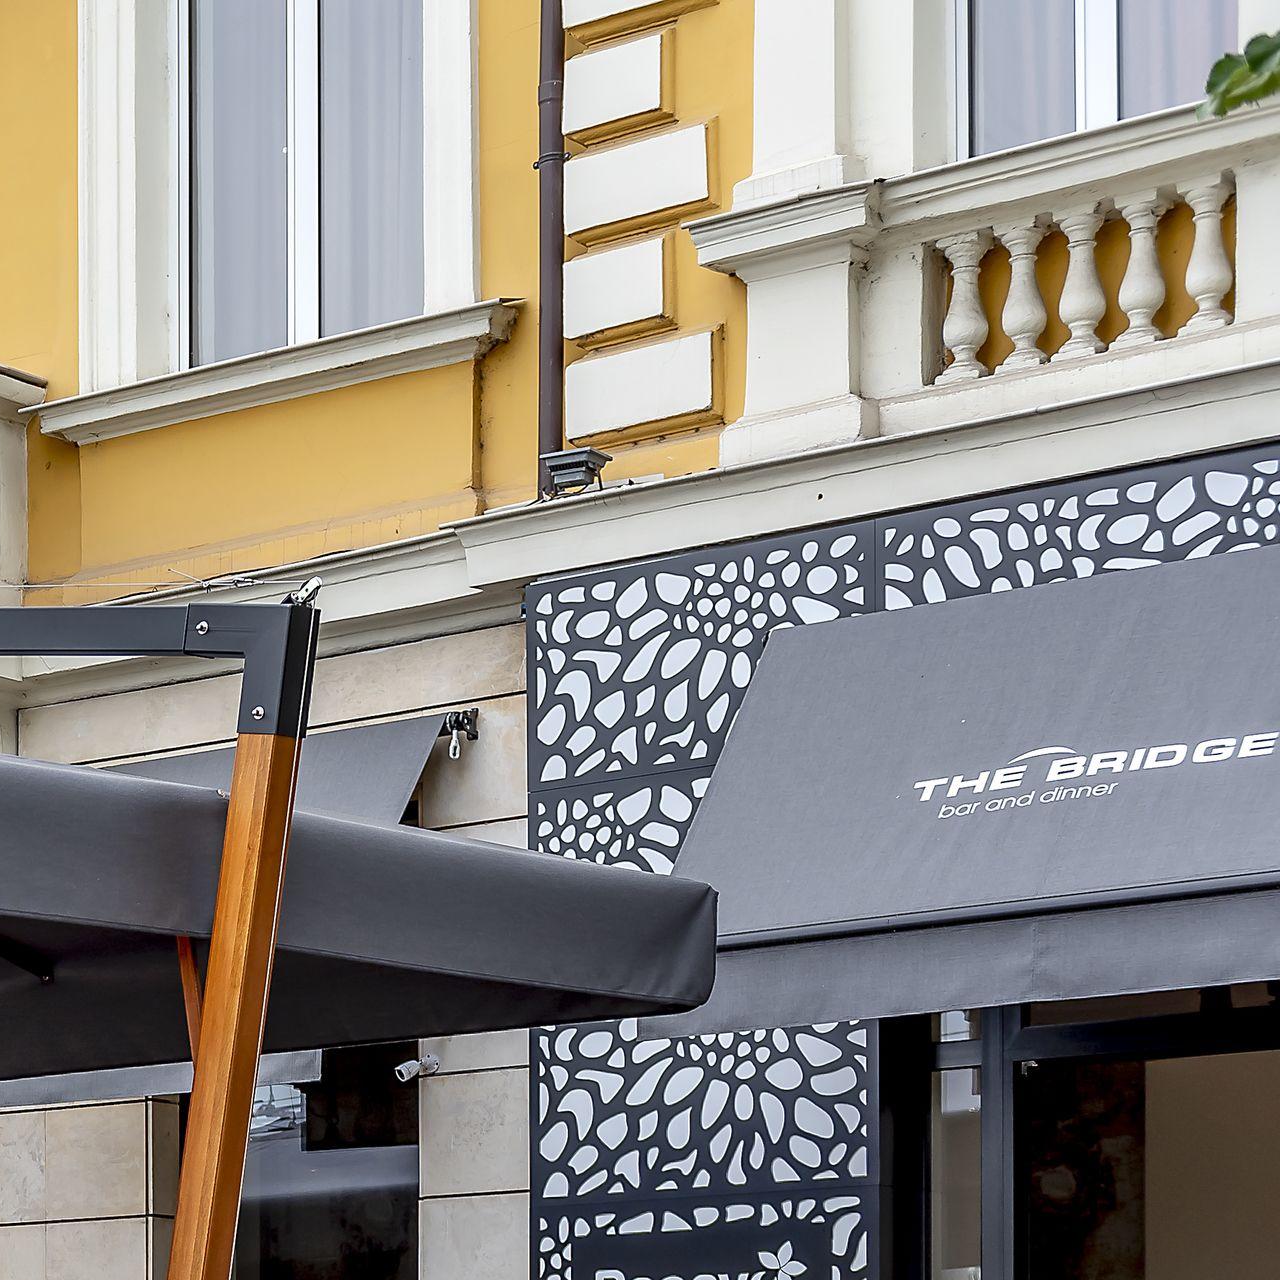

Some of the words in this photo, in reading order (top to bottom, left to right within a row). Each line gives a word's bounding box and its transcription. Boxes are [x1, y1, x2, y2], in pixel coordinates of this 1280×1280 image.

[913, 765, 1028, 802] THE
[1045, 731, 1280, 782] BRIDGE
[937, 803, 980, 820] bar
[985, 790, 1035, 813] and
[1039, 780, 1119, 804] dinner
